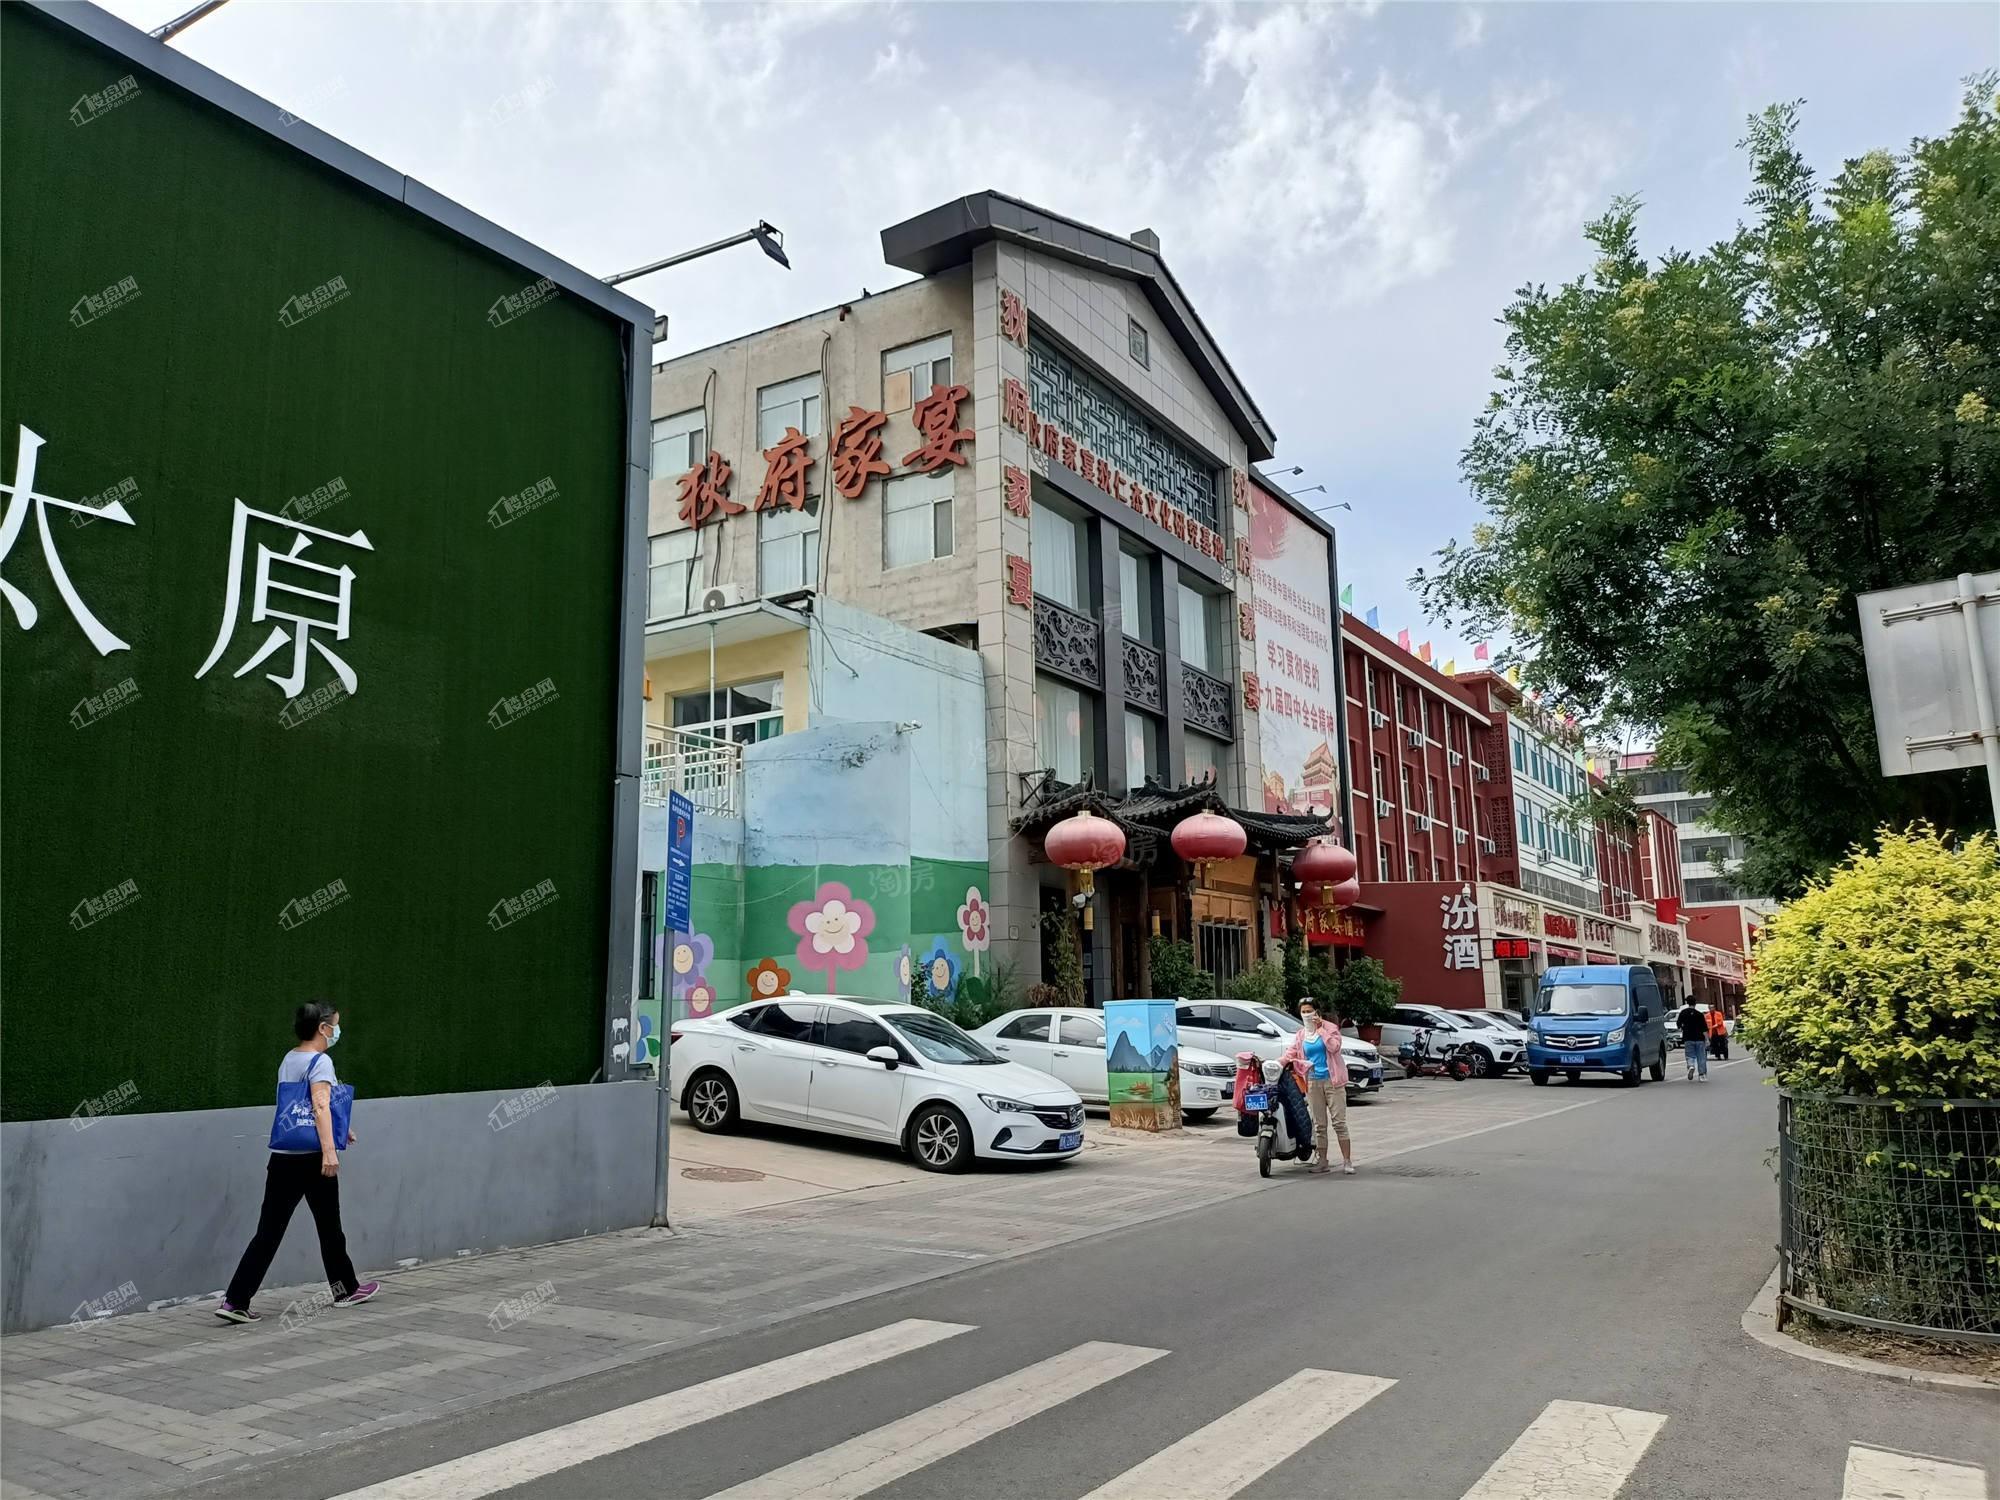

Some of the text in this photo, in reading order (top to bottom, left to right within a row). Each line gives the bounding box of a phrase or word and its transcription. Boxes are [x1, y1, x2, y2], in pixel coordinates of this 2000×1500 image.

[677, 384, 975, 531] 狄府家宴
[1001, 288, 1033, 610] 狄府家宴
[1266, 639, 1320, 693] 学习贯彻党的
[1440, 894, 1480, 970] 汾酒
